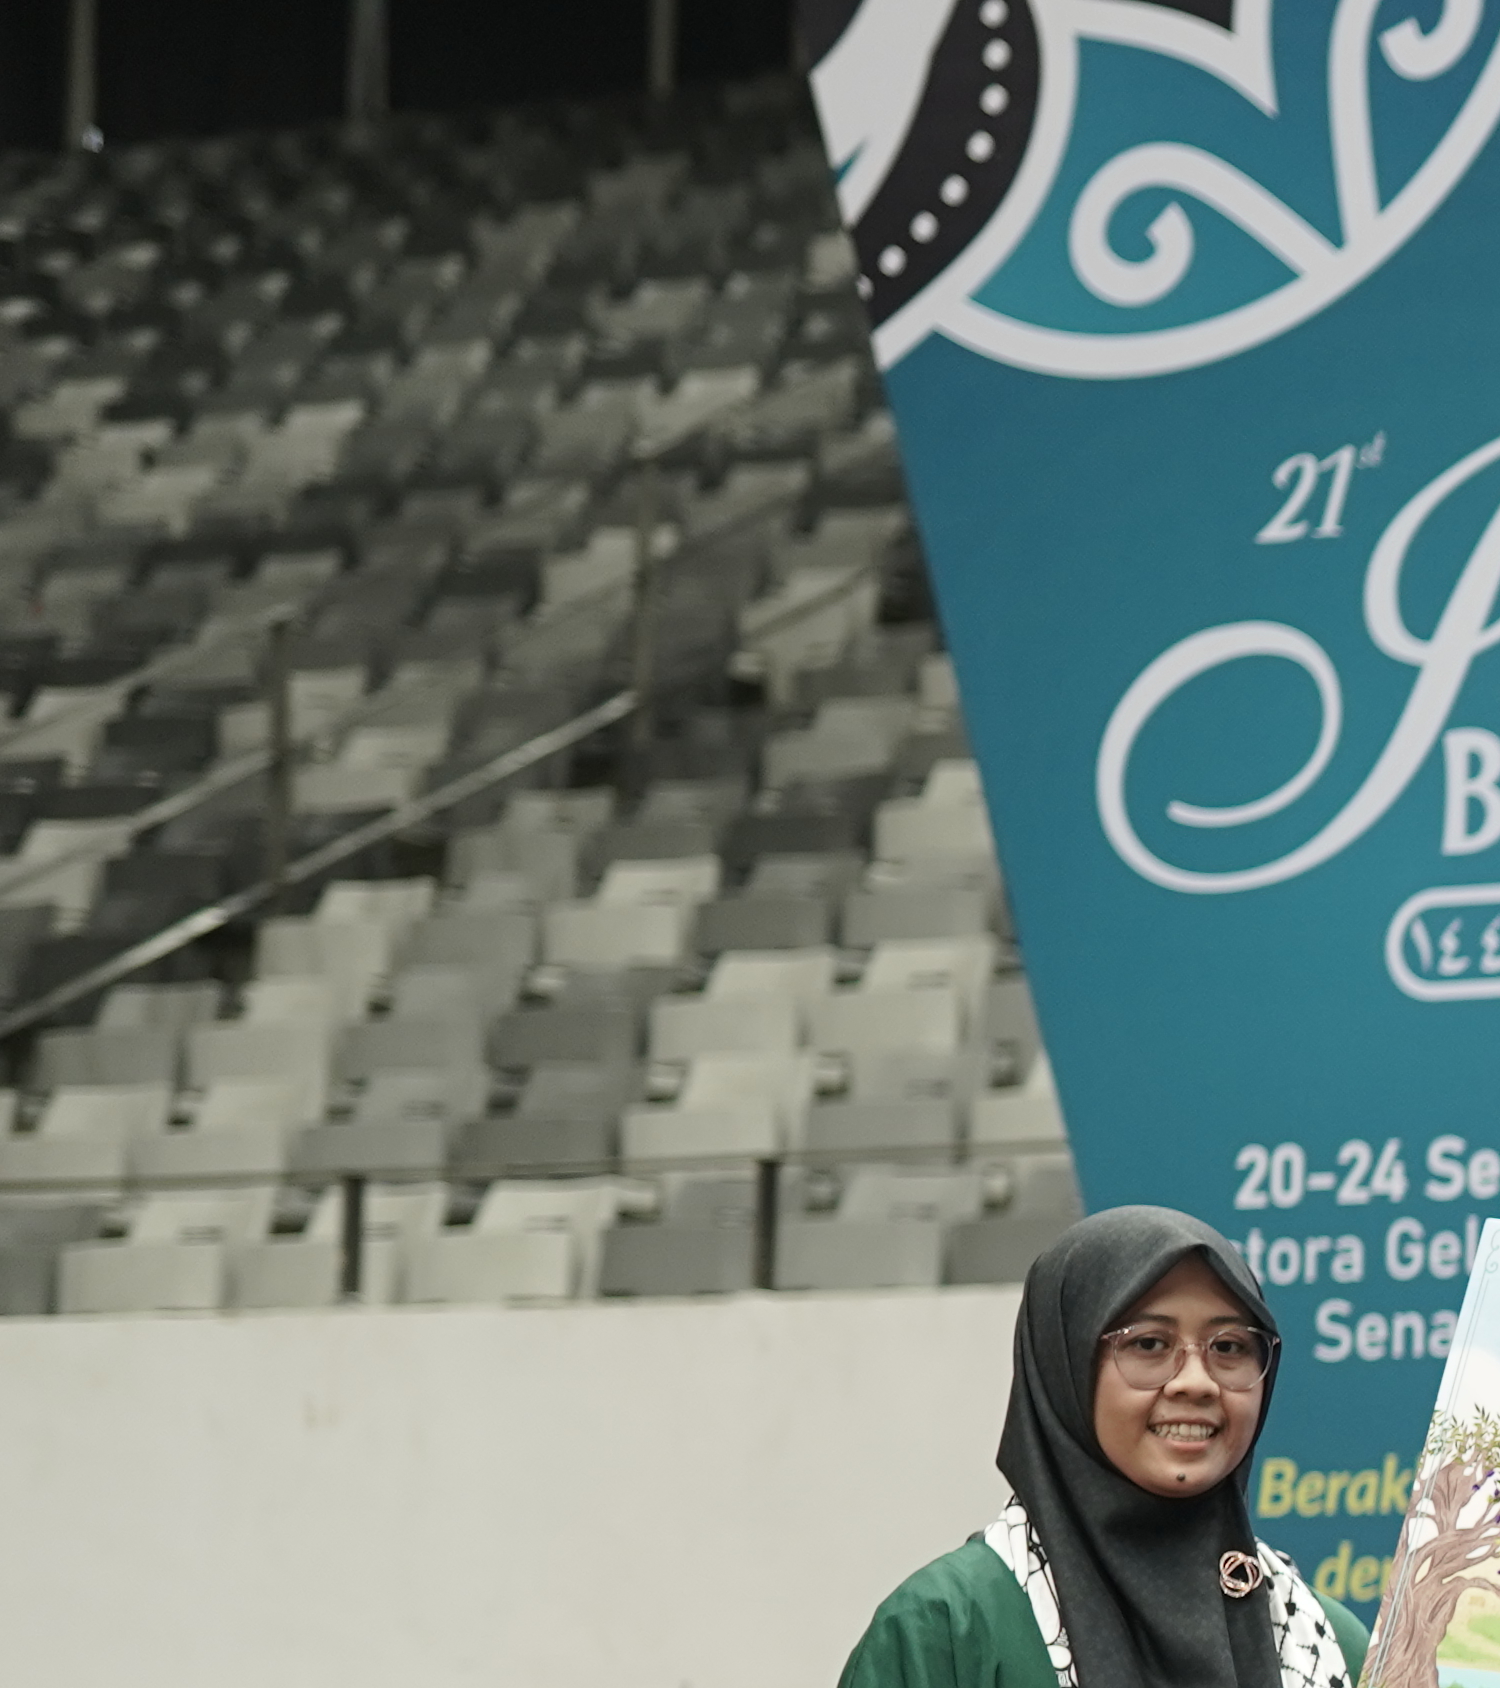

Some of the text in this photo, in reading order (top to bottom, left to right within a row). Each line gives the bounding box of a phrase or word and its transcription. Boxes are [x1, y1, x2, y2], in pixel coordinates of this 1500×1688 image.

[1232, 1138, 1408, 1210] 20-24
[1384, 1213, 1480, 1282] Gel
[1313, 1297, 1460, 1363] Sena
[1257, 1451, 1412, 1519] Berak
